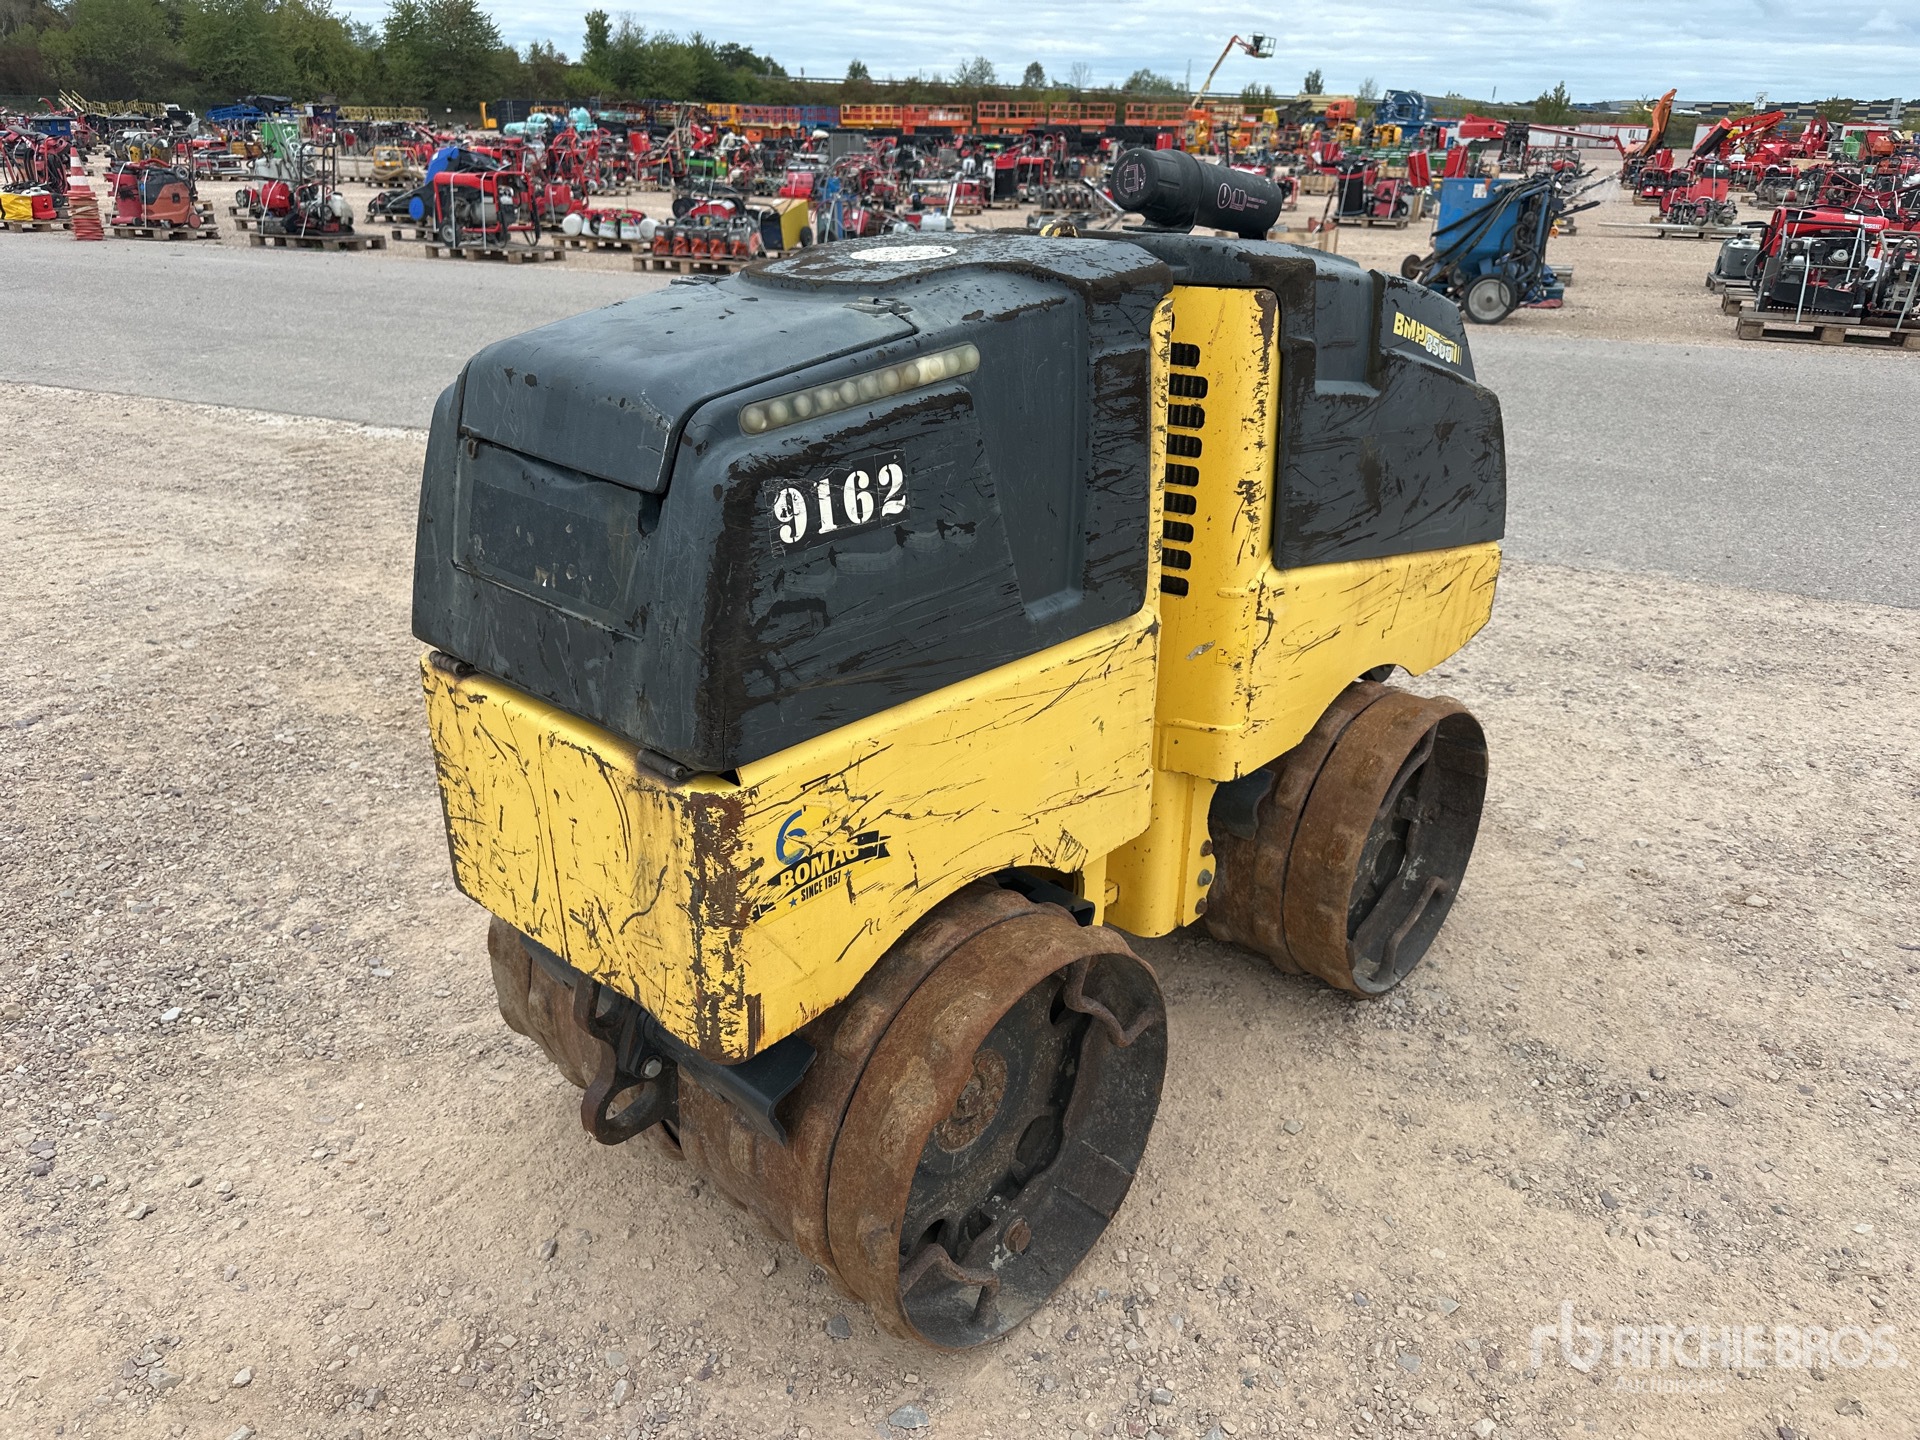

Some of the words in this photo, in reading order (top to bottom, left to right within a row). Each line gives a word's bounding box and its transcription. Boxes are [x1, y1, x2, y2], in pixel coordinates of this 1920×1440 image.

[773, 463, 906, 544] 9162
[800, 879, 823, 902] SINCE
[824, 869, 842, 890] 1957
